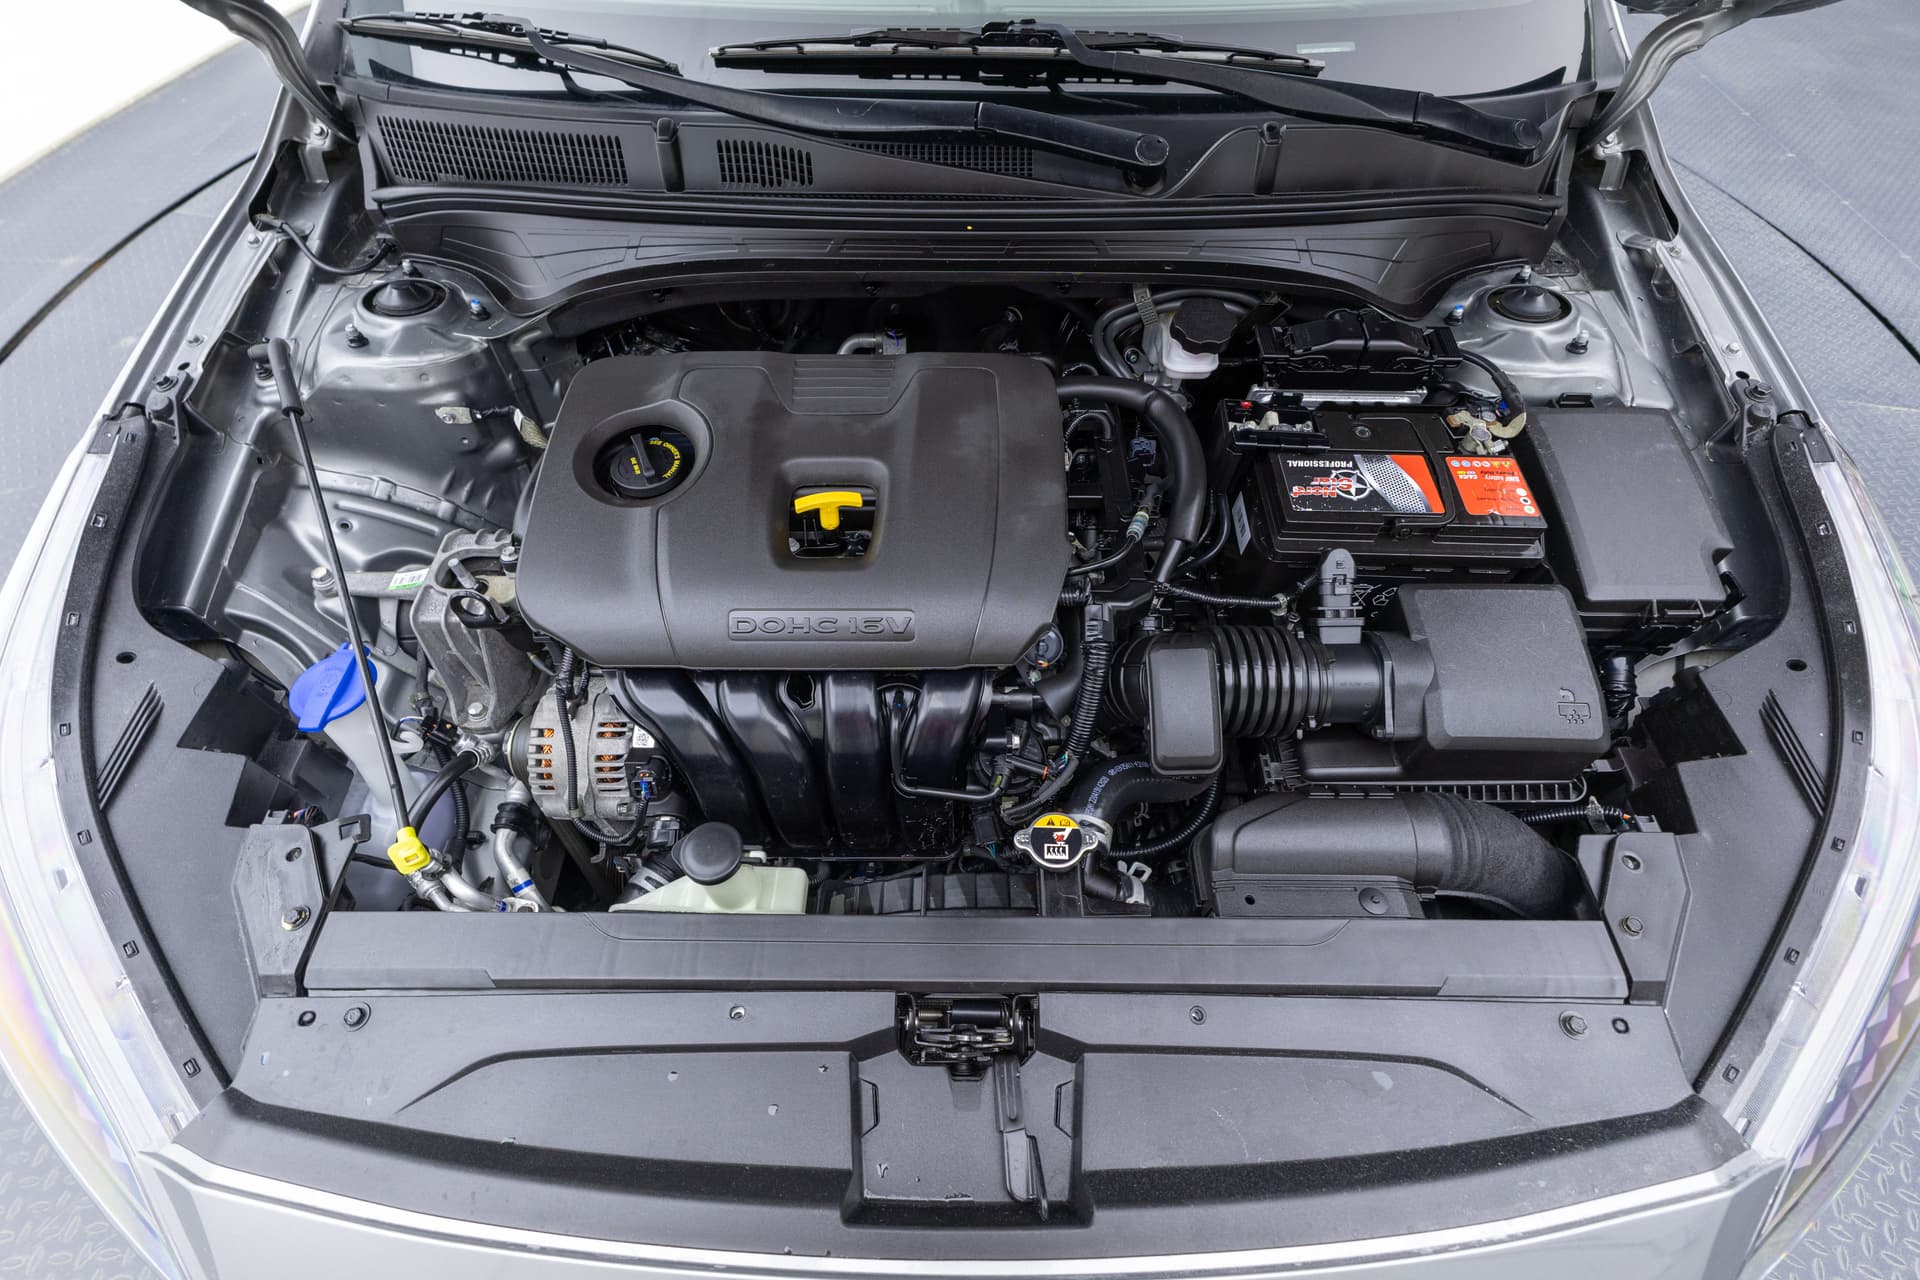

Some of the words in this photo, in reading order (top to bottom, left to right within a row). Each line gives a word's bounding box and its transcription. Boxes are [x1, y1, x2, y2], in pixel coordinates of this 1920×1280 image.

[1287, 460, 1353, 468] PROFESSIONAL
[1310, 477, 1353, 491] Star
[1292, 485, 1338, 498] Nord
[731, 616, 838, 634] DOHC
[848, 616, 912, 634] 16V
